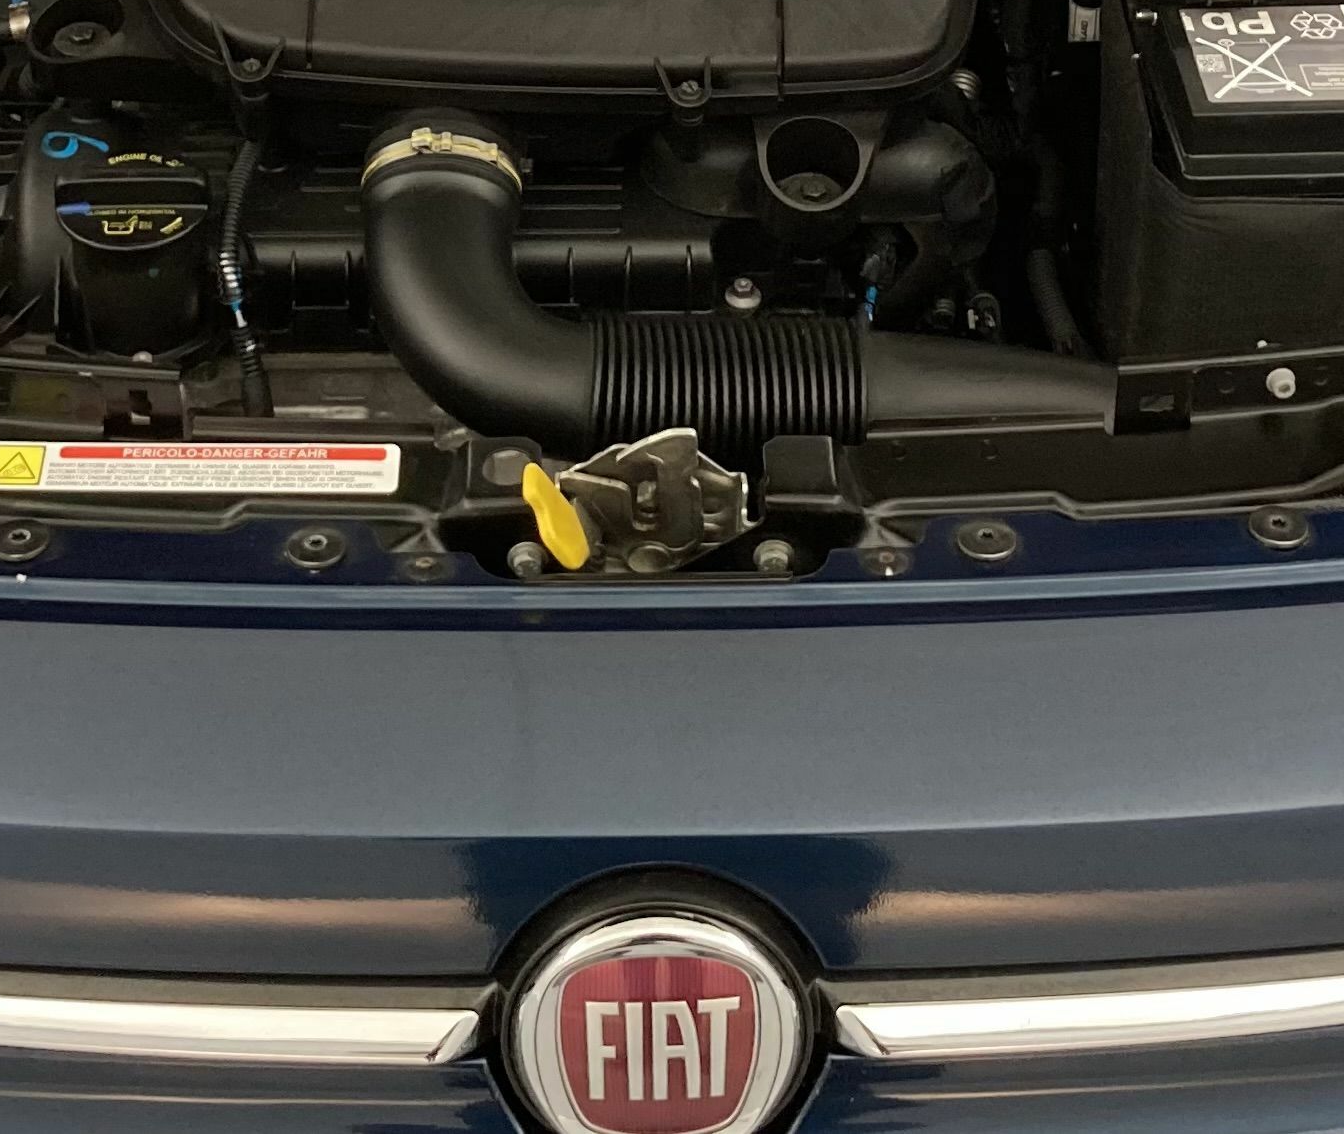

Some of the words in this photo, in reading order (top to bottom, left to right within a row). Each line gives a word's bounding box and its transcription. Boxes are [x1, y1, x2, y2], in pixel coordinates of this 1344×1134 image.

[1201, 11, 1276, 35] Pb
[108, 152, 147, 165] ENGINE
[122, 447, 328, 459] PERICOLO-DANGER-GEFAHR
[584, 995, 741, 1101] FIAT
